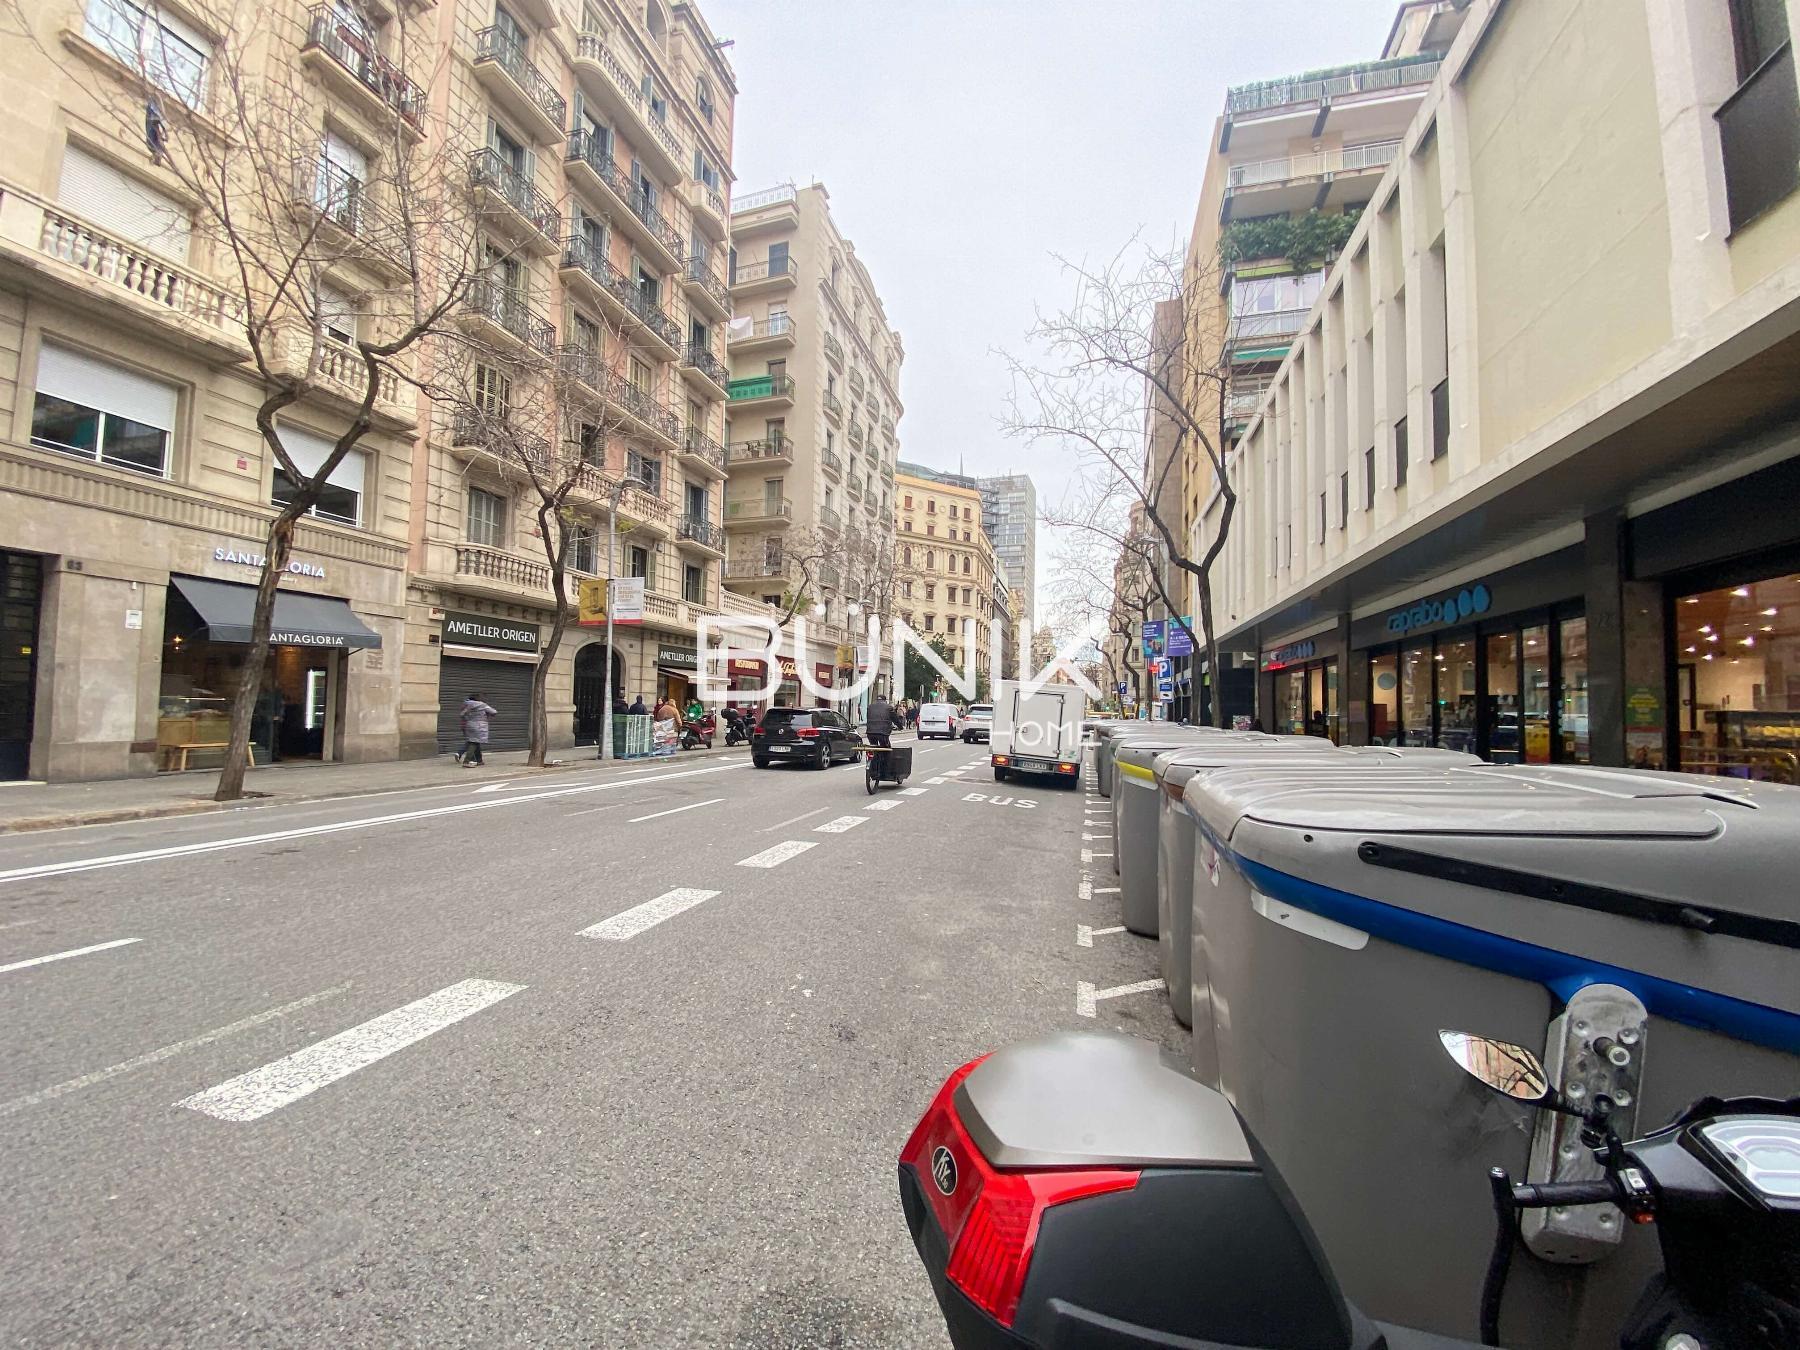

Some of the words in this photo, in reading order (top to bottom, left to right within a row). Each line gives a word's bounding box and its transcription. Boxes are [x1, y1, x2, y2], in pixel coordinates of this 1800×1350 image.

[215, 548, 325, 578] SANTAORIA
[1387, 600, 1443, 635] caprabo
[269, 633, 344, 645] ANTAGLORIA
[447, 620, 500, 639] AMETLLER
[501, 628, 536, 643] ORIGEN
[660, 650, 685, 662] AMETLLER
[1159, 662, 1168, 678] P
[961, 793, 1039, 809] BUS
